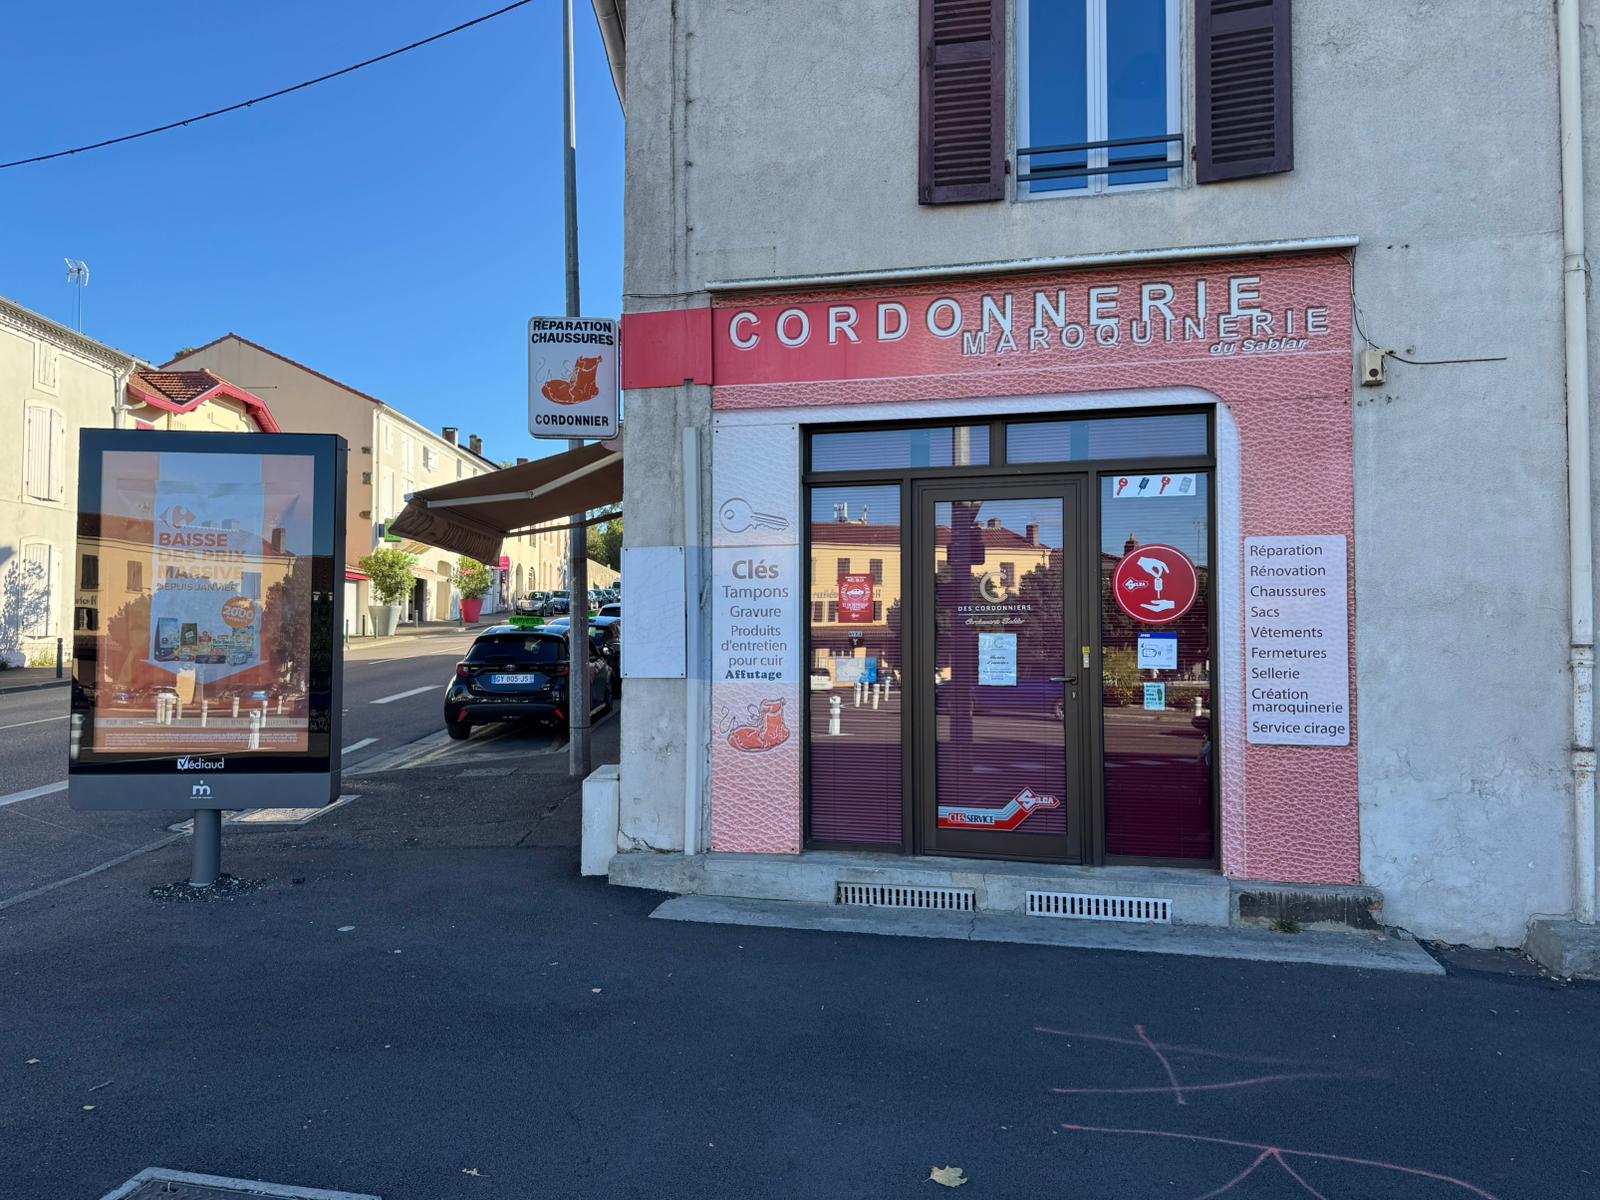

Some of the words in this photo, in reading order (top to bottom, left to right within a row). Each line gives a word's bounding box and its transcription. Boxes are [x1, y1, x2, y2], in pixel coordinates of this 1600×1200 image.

[728, 275, 1262, 351] CORDONNERIE
[533, 320, 612, 333] REPARATION
[961, 307, 1329, 356] MAROQUINERIE
[531, 332, 614, 346] CHAUSSURES
[1209, 340, 1235, 356] du
[1241, 337, 1309, 353] Sablar
[535, 414, 609, 427] CORDONNIER
[160, 532, 228, 547] BAISSE
[1250, 544, 1322, 559] Réparation
[731, 559, 779, 580] Clés
[1250, 564, 1326, 577] Rénovation
[722, 585, 789, 601] Tampons
[1250, 585, 1326, 598] Chaussures
[223, 606, 254, 620] 2000
[730, 605, 782, 618] Gravure
[975, 604, 1031, 612] CORDONNIERS
[1251, 606, 1280, 618] Sacs
[731, 625, 781, 637] Produits
[1251, 627, 1323, 639] Vêtements
[721, 640, 787, 652] d'entretien
[1251, 647, 1327, 659] Fermetures
[728, 656, 757, 669] pour
[760, 656, 784, 667] cuir
[725, 670, 782, 681] Affutage
[1251, 667, 1300, 680] Sellerie
[1251, 688, 1309, 700] Création
[1252, 701, 1343, 716] maroquinerie
[1252, 721, 1301, 734] Service
[1304, 722, 1346, 737] cirage
